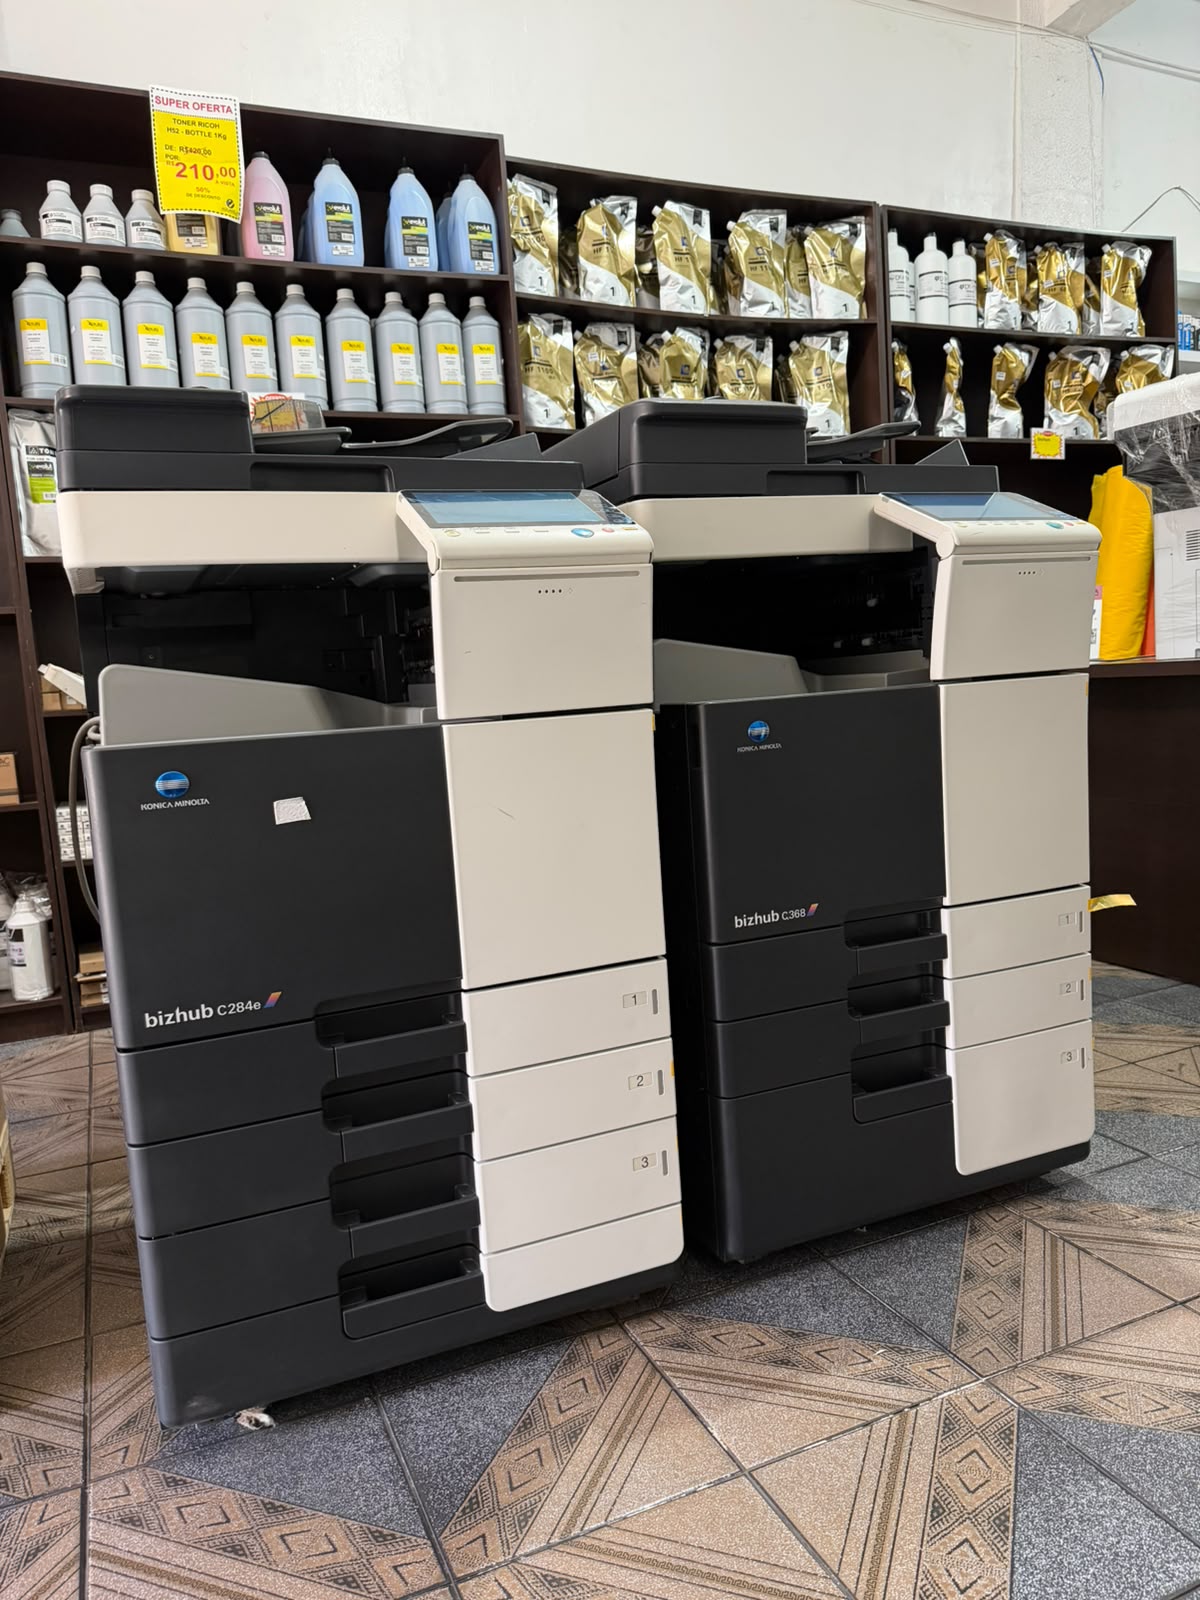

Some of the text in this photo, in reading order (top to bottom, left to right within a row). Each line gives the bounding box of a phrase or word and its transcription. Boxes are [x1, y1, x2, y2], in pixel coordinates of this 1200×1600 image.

[155, 95, 233, 114] SUPER OFERTA
[172, 118, 220, 129] TONER RICOH
[185, 129, 212, 138] BOTTLE
[214, 132, 227, 140] 1Kg
[175, 162, 237, 181] 210,00
[538, 276, 543, 286] 1
[610, 286, 615, 296] 1
[691, 295, 696, 305] 1
[843, 303, 848, 312] 1
[544, 408, 549, 419] 1
[825, 419, 830, 428] 1
[1073, 427, 1078, 436] 1
[737, 742, 782, 753] KONICA MINOLTA
[140, 798, 210, 811] KONICA MINOLTA
[734, 907, 806, 929] bizhub C368
[1065, 914, 1070, 925] 1
[1065, 983, 1071, 993] 2
[632, 994, 637, 1006] 1
[144, 1000, 261, 1028] bizhub C284e
[1066, 1051, 1072, 1062] 3
[636, 1075, 644, 1087] 2
[641, 1156, 649, 1168] 3
